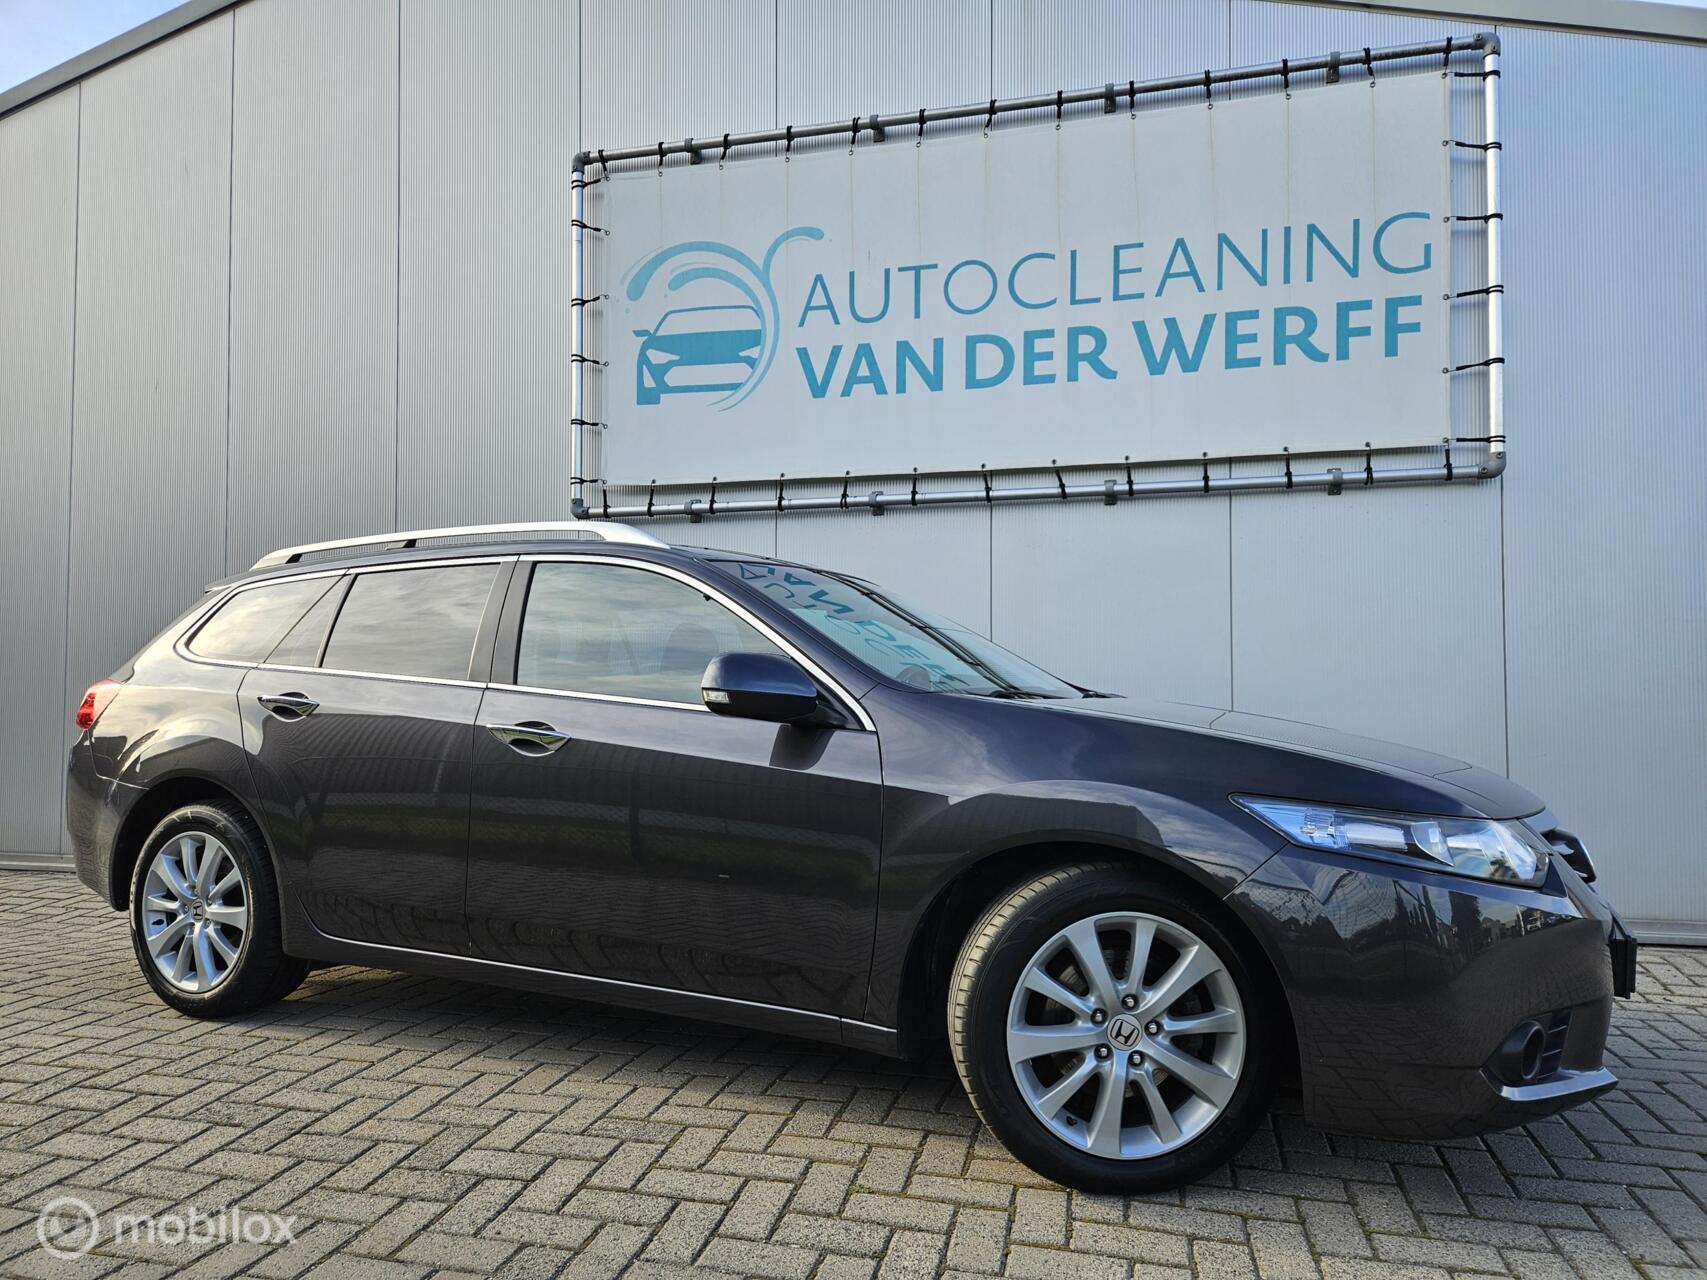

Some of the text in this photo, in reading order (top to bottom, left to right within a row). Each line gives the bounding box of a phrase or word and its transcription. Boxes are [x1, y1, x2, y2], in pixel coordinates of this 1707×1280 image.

[798, 211, 1433, 328] AUTOCLEANING
[795, 294, 1423, 400] VAN DER WERFF
